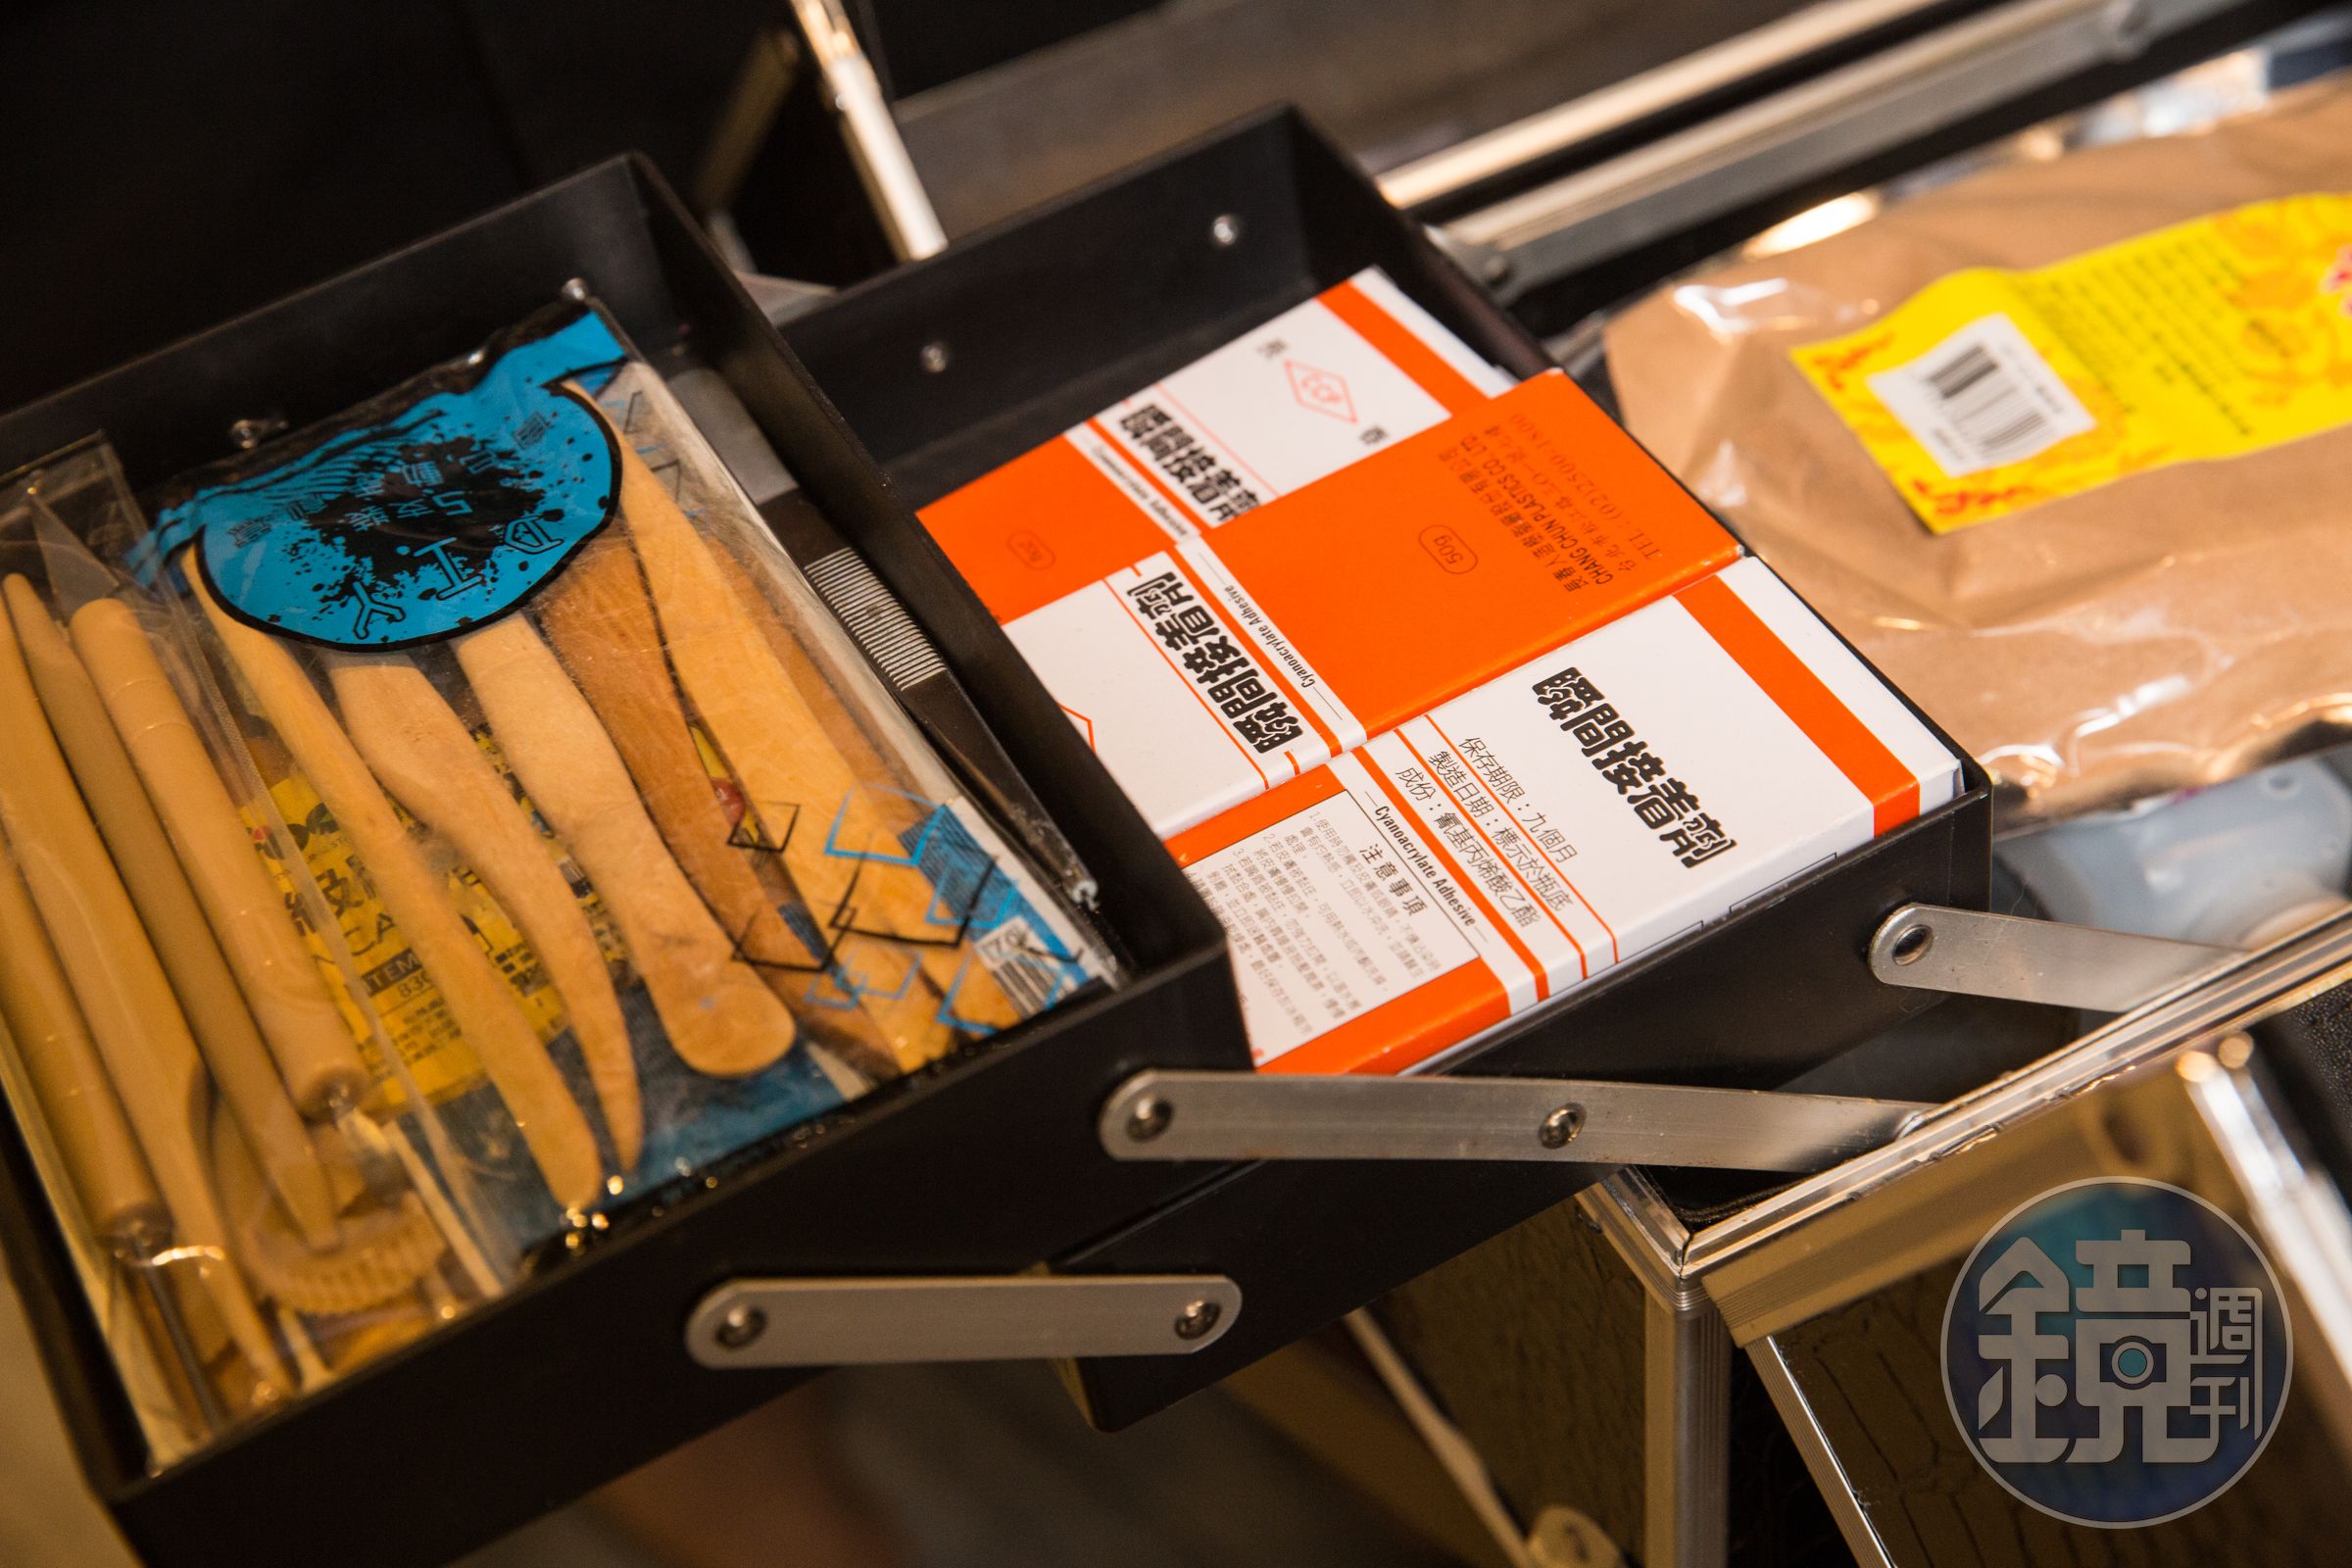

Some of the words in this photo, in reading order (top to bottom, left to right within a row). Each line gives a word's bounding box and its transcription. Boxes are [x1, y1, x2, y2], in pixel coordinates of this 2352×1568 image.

[1497, 472, 1547, 522] PLASTICS
[1434, 534, 1464, 564] 50g
[1543, 518, 1579, 550] CHUN
[1568, 546, 1614, 585] CHANG
[1224, 585, 1263, 626] Adhesive
[1258, 624, 1316, 688] Cyanoacrylate
[1374, 805, 1437, 880] Cyanoacrylate
[1433, 877, 1477, 926] Adhesive
